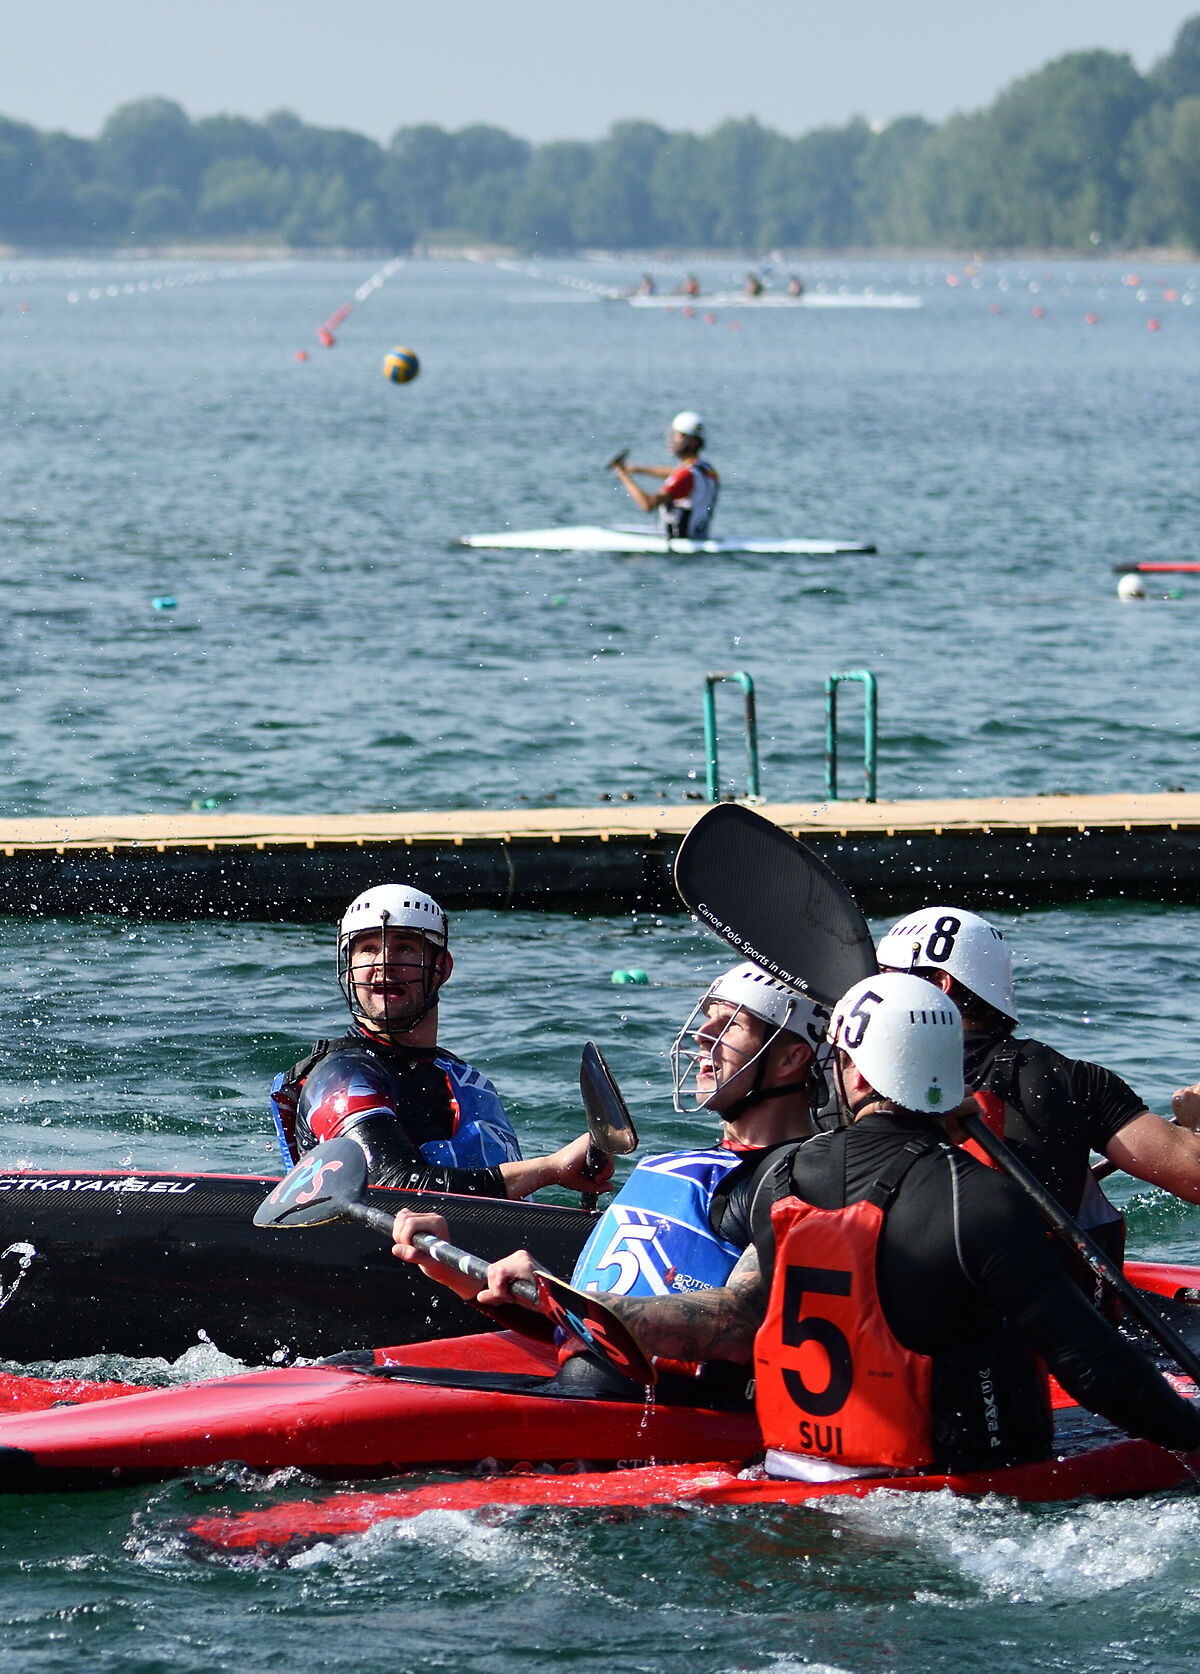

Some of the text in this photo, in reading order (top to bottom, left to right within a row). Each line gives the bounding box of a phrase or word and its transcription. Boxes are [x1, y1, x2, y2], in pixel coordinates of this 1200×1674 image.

[697, 903, 809, 991] Canoe Polo Sports in my life
[925, 915, 962, 963] 8
[844, 990, 884, 1049] 5
[269, 1156, 343, 1204] CPS
[585, 1222, 659, 1295] 5
[781, 1264, 853, 1417] 5
[799, 1420, 843, 1455] SUI
